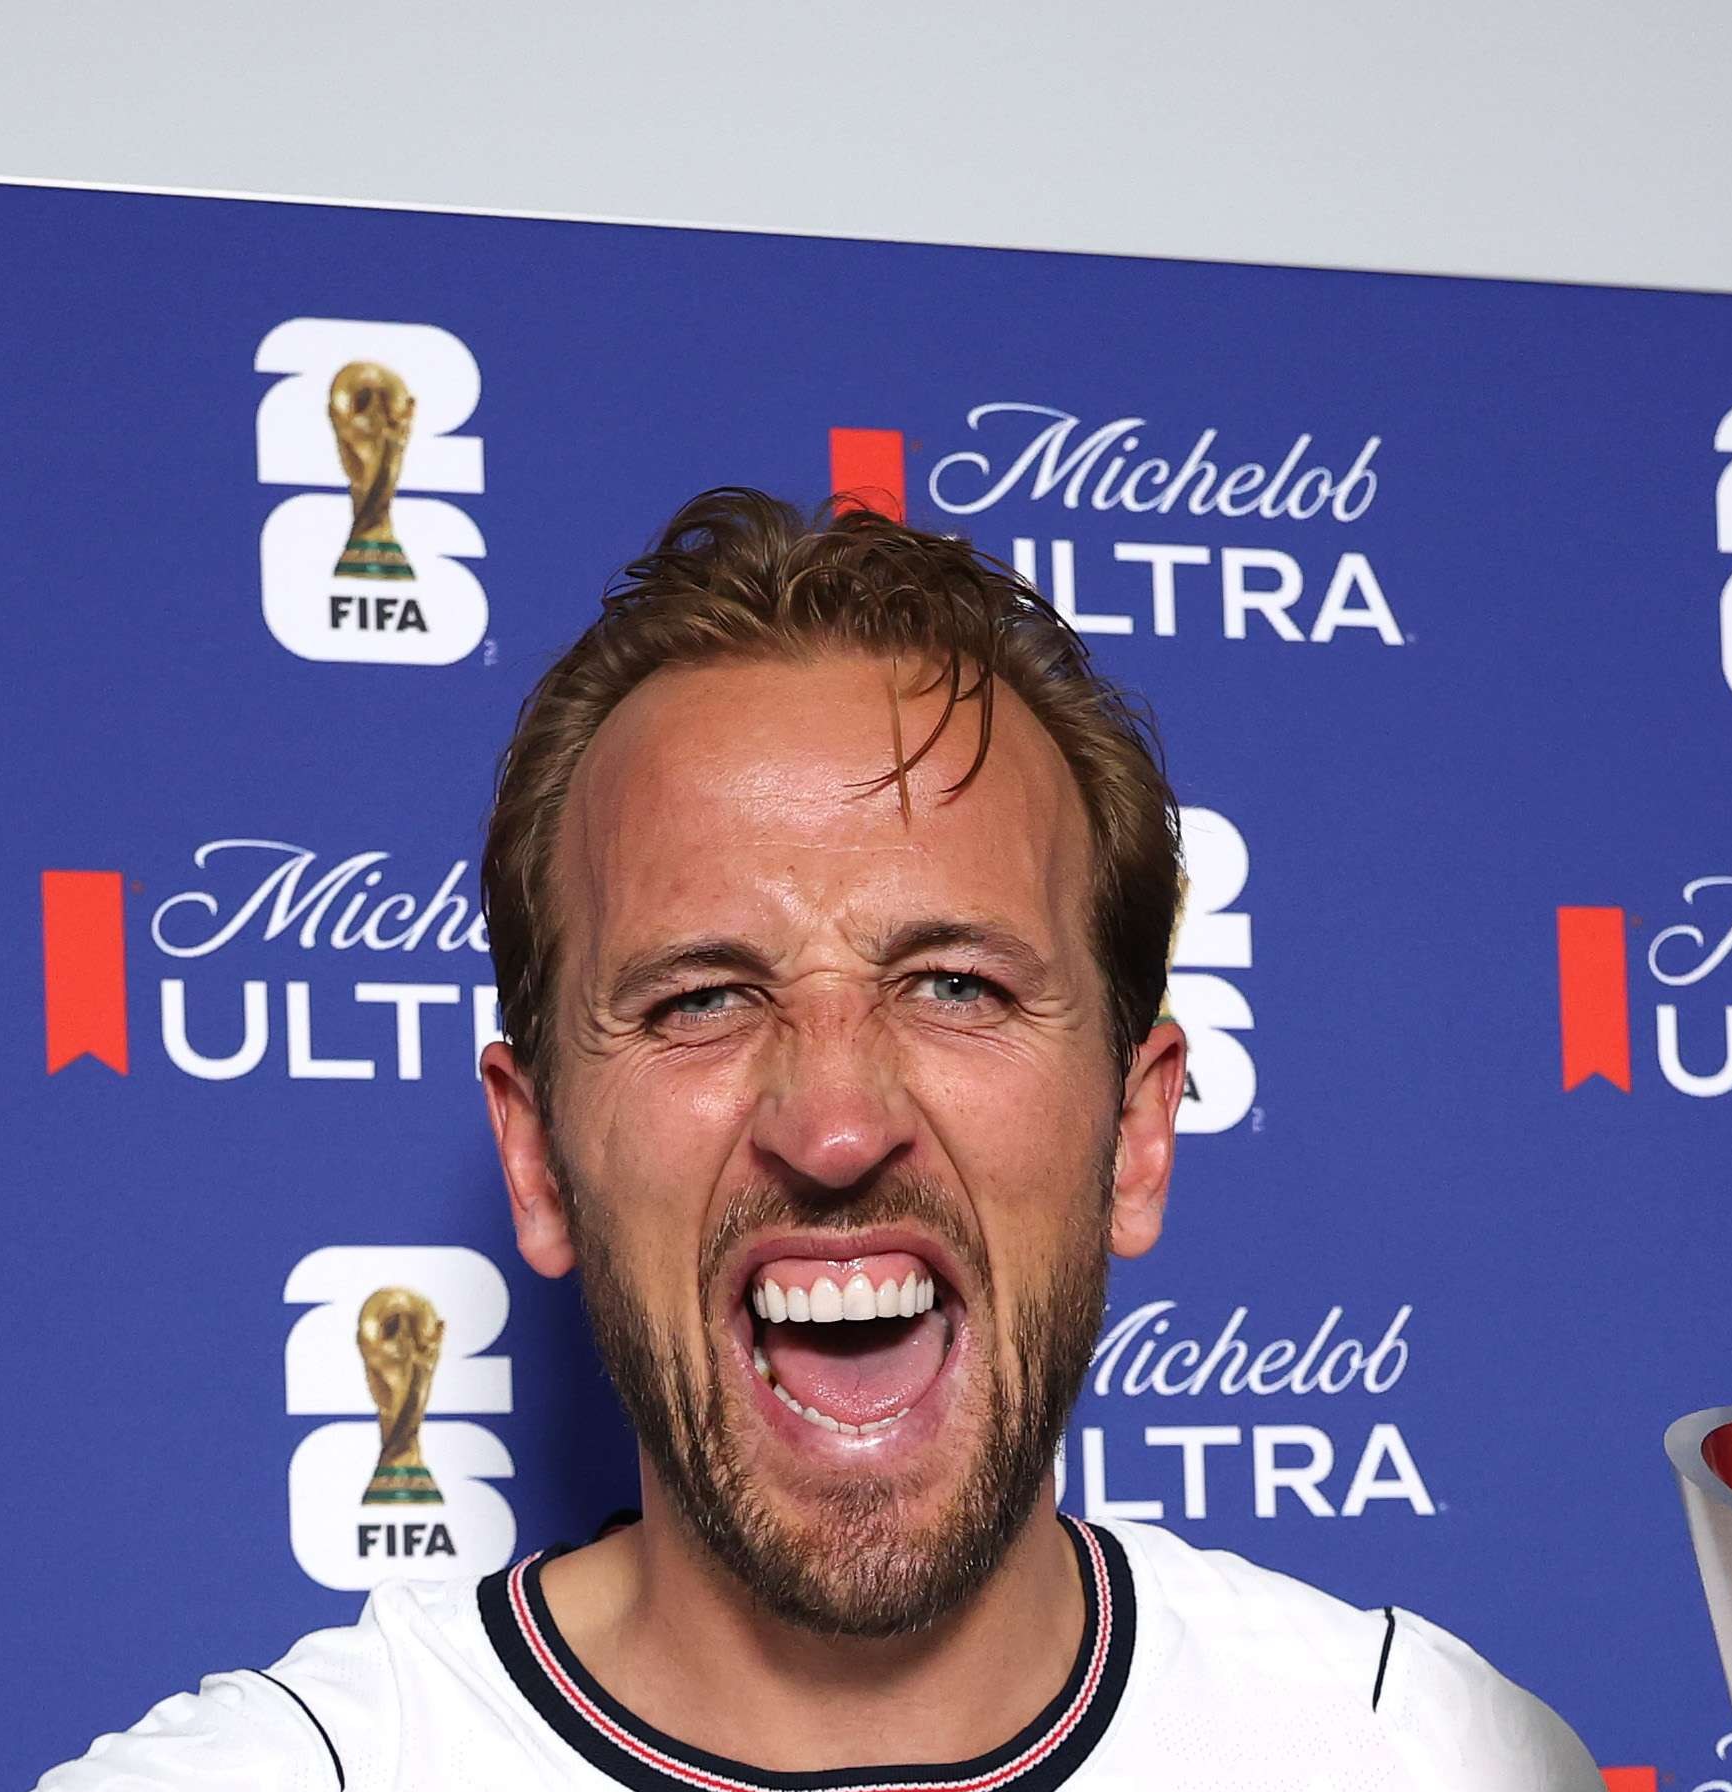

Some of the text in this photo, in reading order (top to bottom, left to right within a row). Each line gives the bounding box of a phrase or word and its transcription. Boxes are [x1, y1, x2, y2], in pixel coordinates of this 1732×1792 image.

[928, 402, 1382, 523] Michelob
[329, 595, 428, 633] FIFA
[151, 838, 491, 957] Mich
[160, 980, 504, 1082] ULT
[1054, 1423, 1436, 1519] LTRA
[357, 1523, 456, 1558] FIFA
